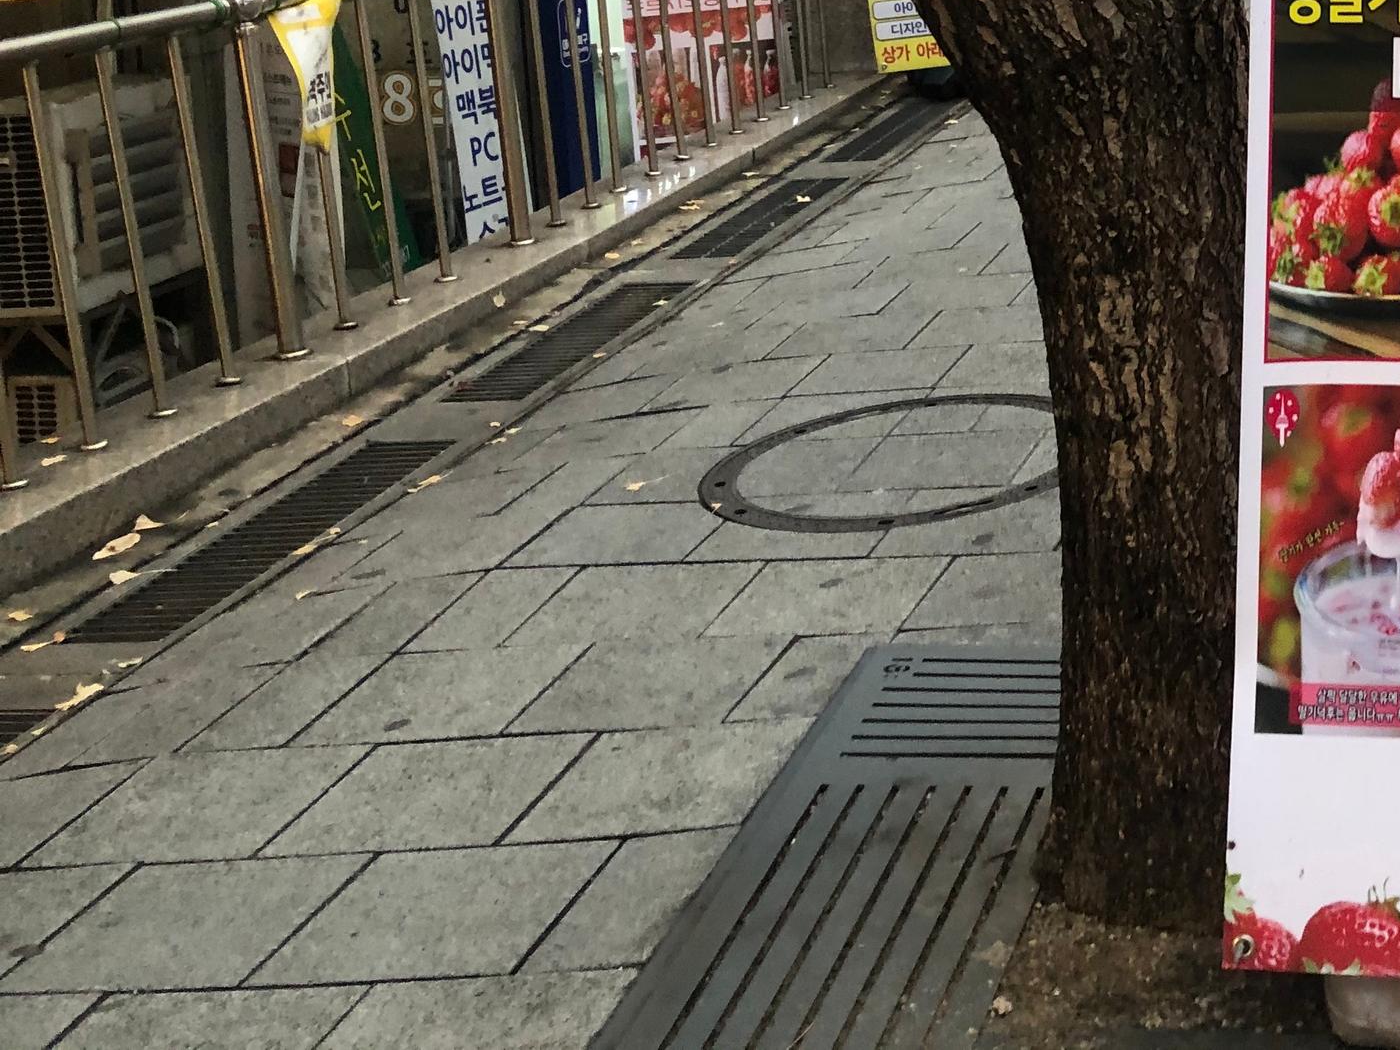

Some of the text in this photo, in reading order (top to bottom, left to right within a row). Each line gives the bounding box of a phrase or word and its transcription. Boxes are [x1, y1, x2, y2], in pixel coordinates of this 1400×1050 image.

[881, 42, 911, 64] 상가
[456, 85, 498, 126] 맥북
[469, 131, 500, 167] PC
